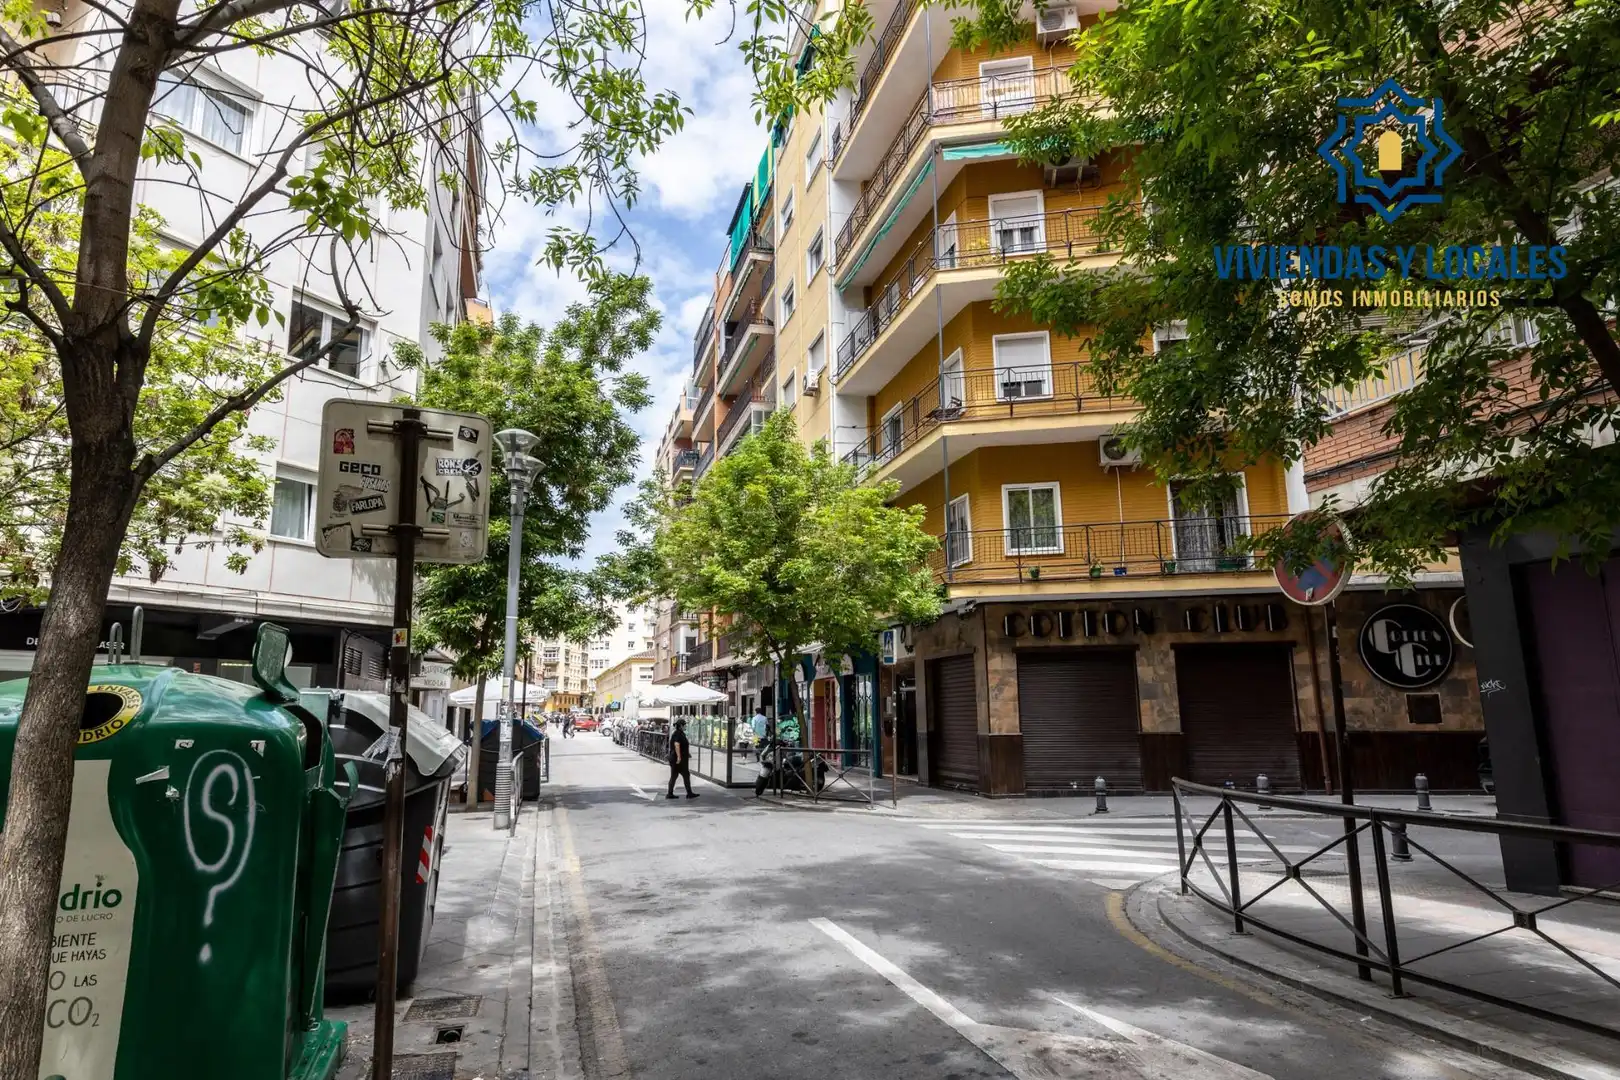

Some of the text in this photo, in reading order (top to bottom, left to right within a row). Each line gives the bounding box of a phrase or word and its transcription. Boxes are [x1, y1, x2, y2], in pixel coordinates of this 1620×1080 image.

[351, 497, 384, 512] FARLOPA
[1002, 602, 1289, 641] COTTON CLUB
[95, 640, 126, 651] ASER
[97, 685, 141, 709] ENVASES
[82, 719, 124, 742] DRIO
[59, 883, 123, 911] drio
[66, 914, 79, 923] DE
[81, 912, 114, 923] LUCRO
[50, 932, 98, 949] BIENTE
[71, 948, 107, 963] HAYAS
[73, 974, 98, 988] LAS
